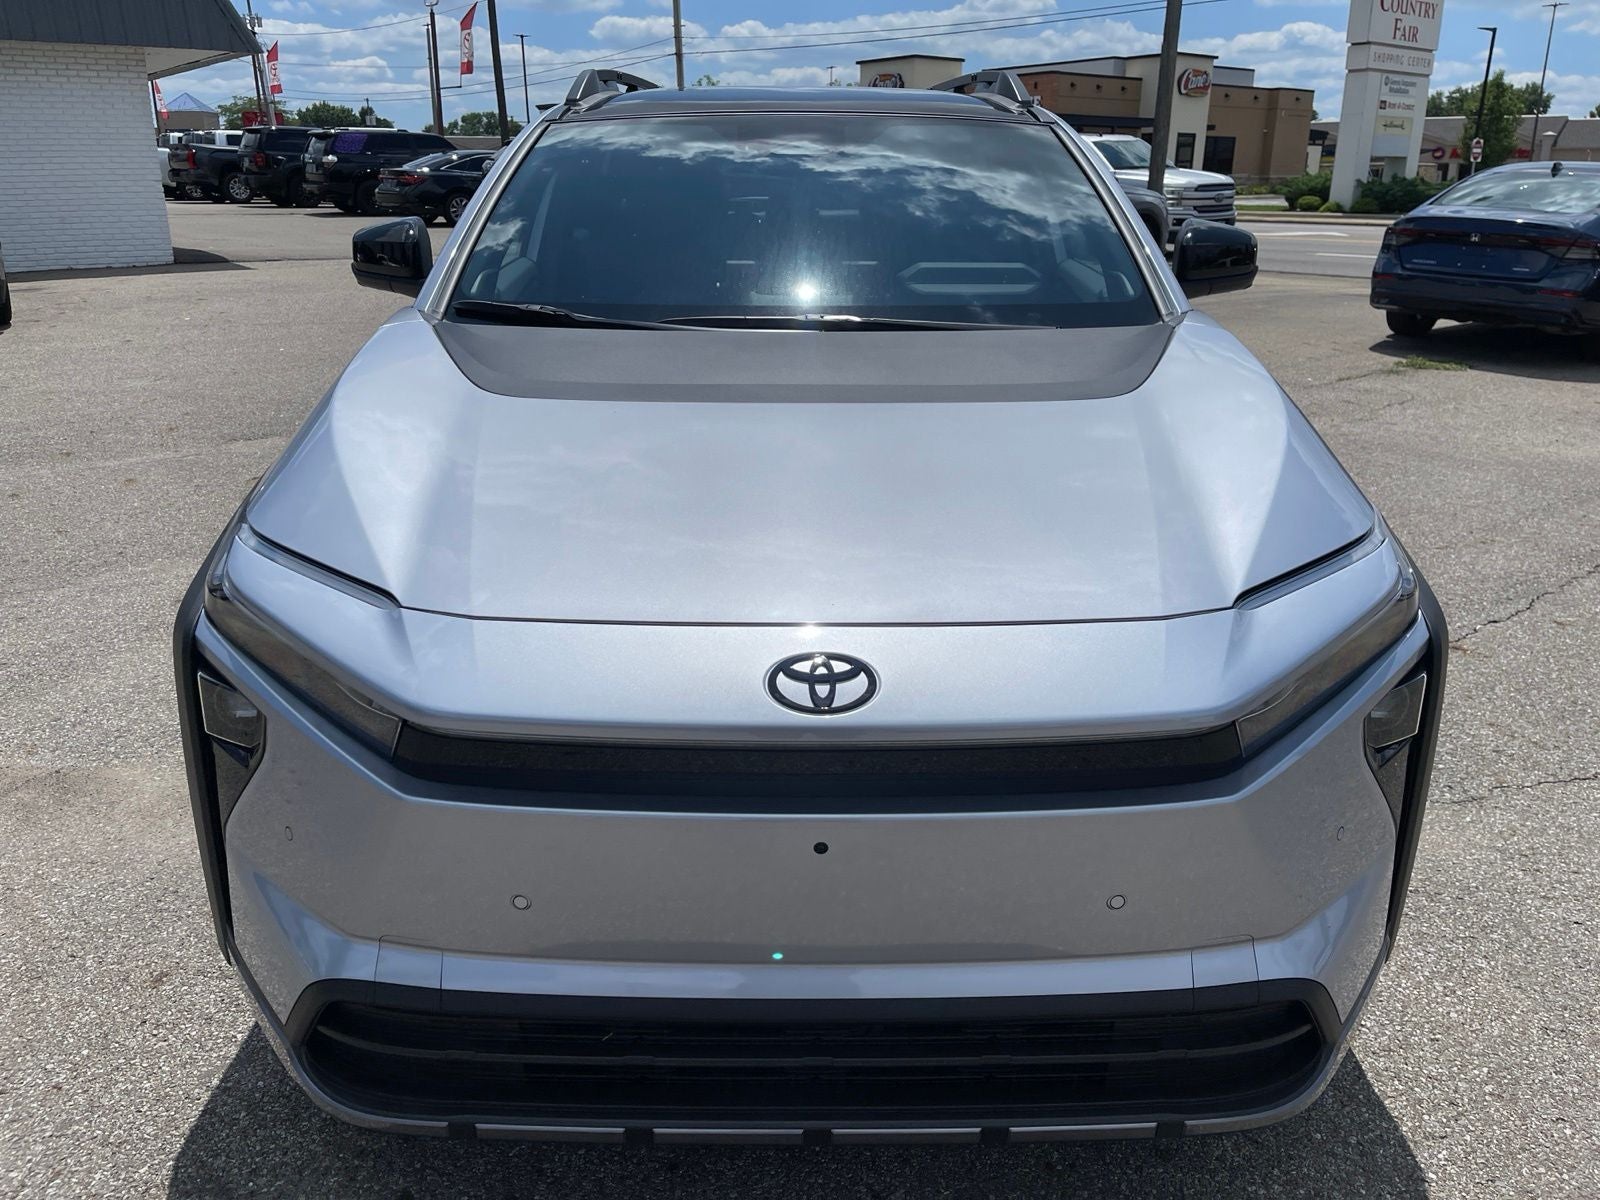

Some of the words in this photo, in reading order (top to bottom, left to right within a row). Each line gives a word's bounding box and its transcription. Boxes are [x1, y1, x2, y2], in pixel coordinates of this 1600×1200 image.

[1380, 0, 1438, 19] COUNTRY
[1392, 18, 1419, 43] FAIR
[1373, 51, 1405, 65] SHOPPING
[1407, 56, 1431, 68] CENTER
